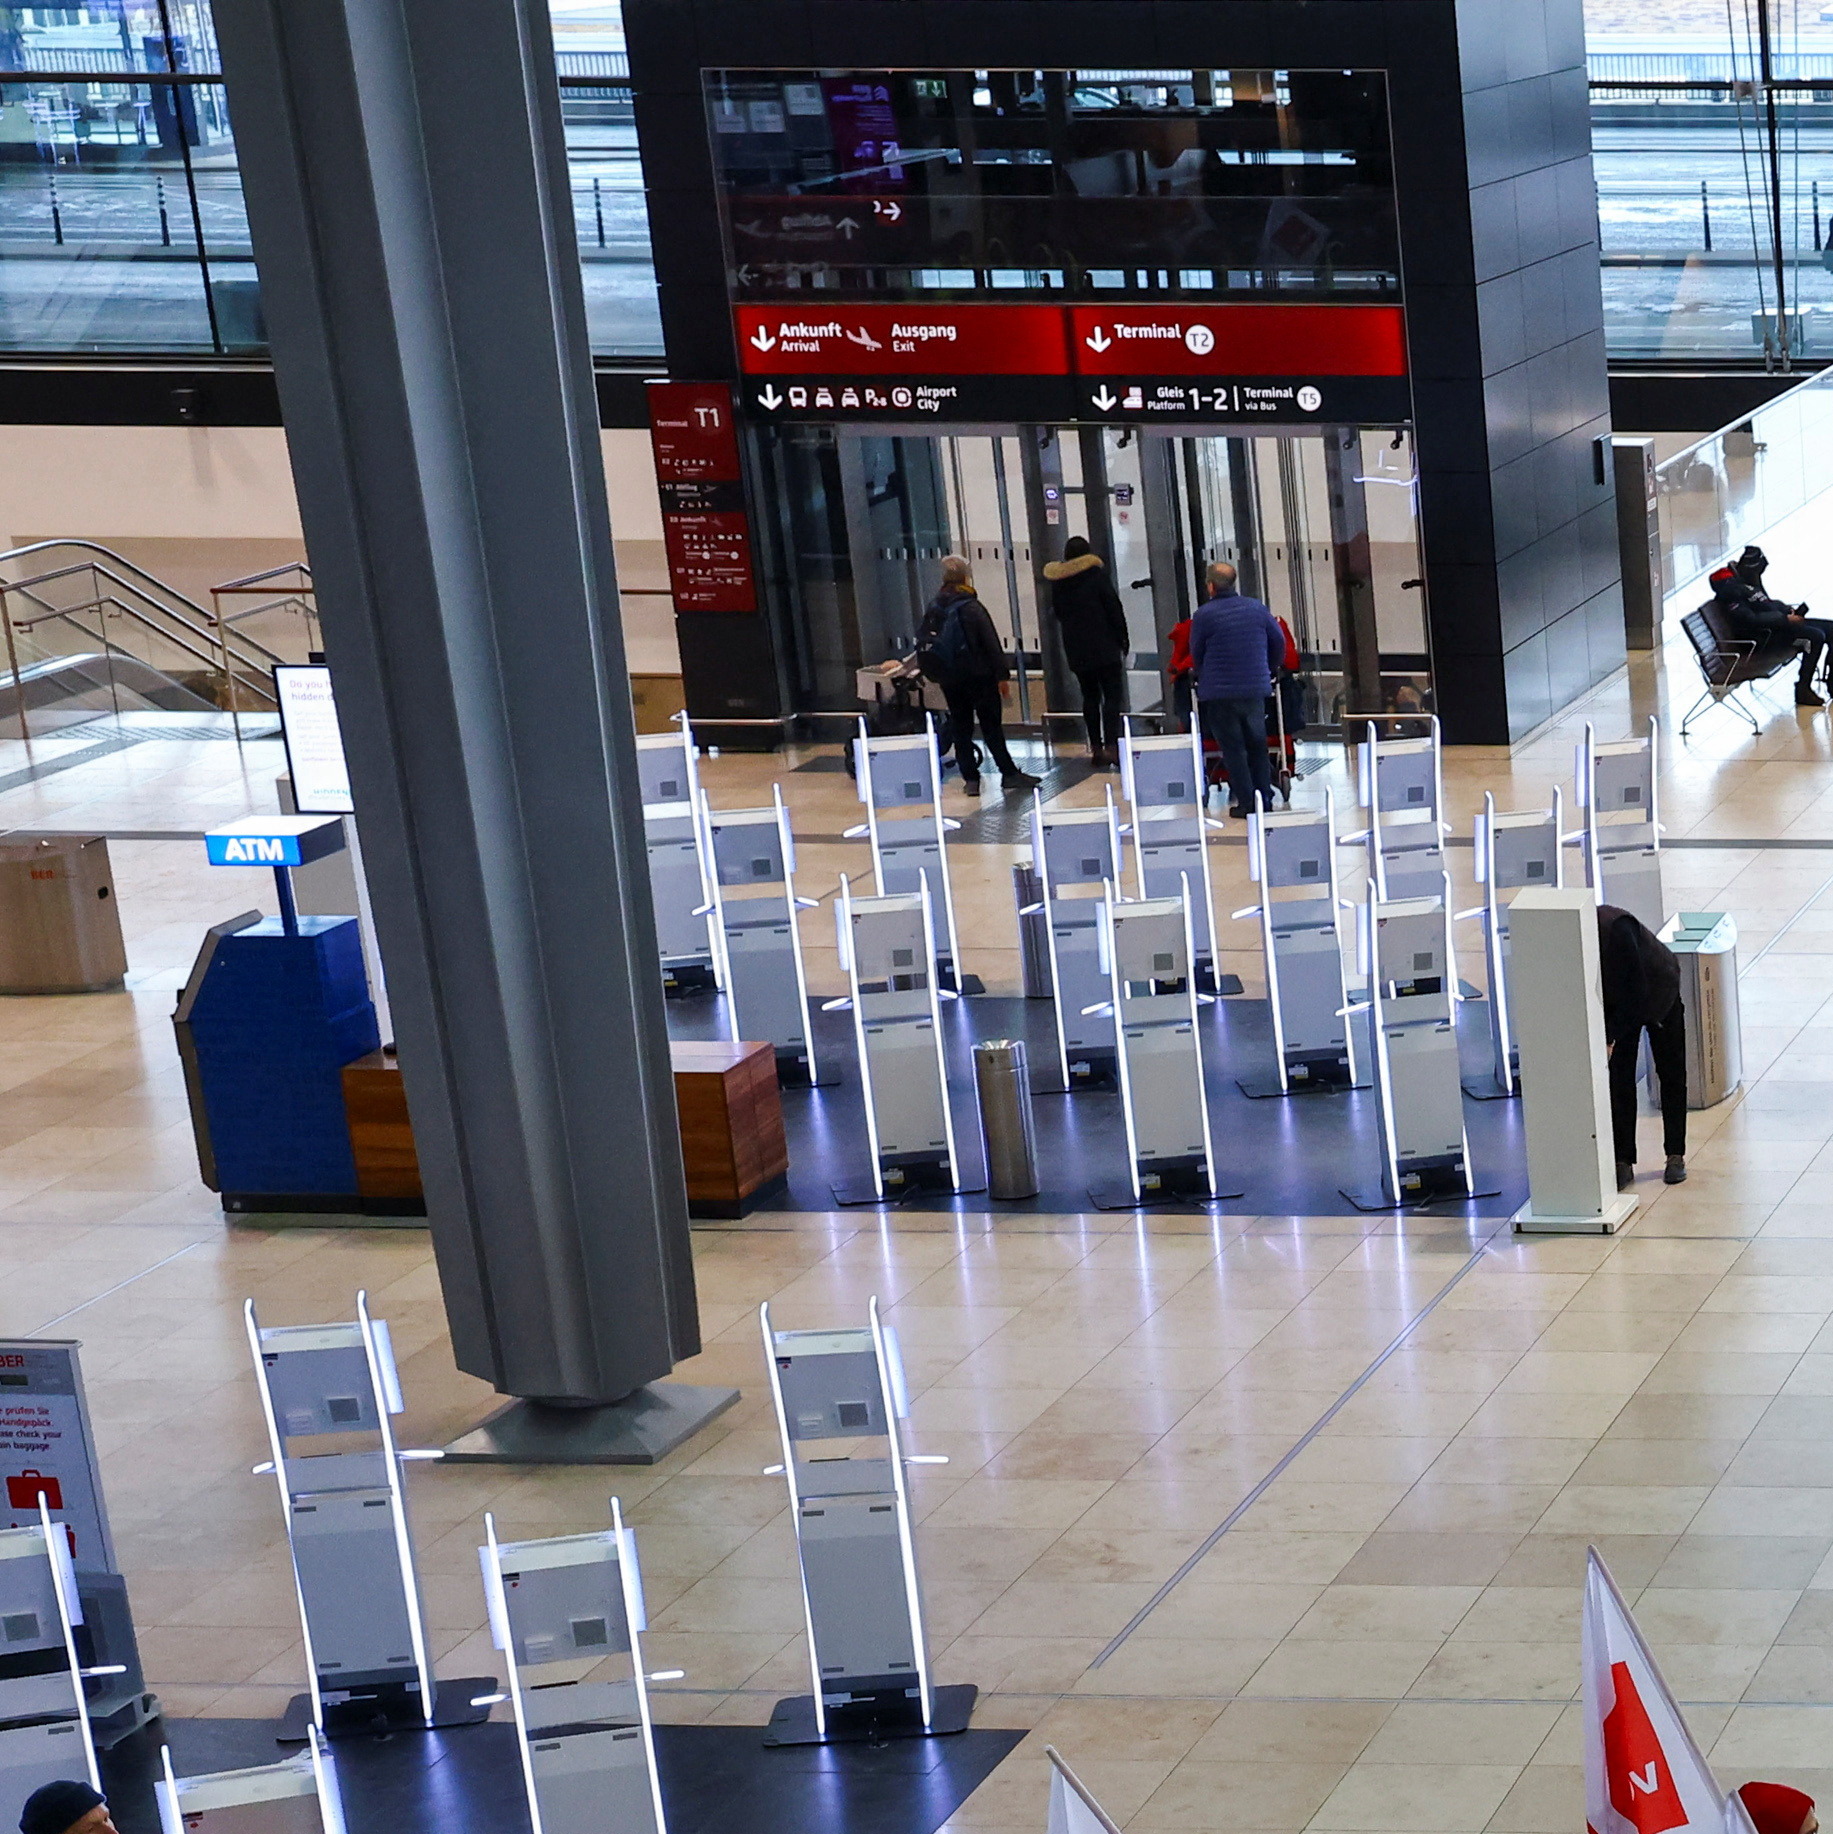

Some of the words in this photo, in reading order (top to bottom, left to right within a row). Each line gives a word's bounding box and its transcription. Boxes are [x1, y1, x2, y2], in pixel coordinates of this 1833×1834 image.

[779, 322, 843, 338] Ankunft
[891, 324, 957, 341] Ausgang
[1114, 324, 1181, 339] Terminal
[1190, 333, 1209, 347] T2
[781, 340, 820, 352] Arrival
[893, 341, 915, 352] Exit
[916, 386, 957, 398] Airport
[1157, 386, 1184, 398] Gleis
[1244, 387, 1293, 398] Terminal
[1302, 393, 1317, 405] T5
[917, 400, 940, 412] City
[1147, 400, 1185, 411] Platform
[1245, 400, 1259, 411] via
[1260, 401, 1277, 411] Bus
[694, 408, 719, 427] T1
[225, 838, 285, 861] ATM
[0, 1355, 24, 1368] BER
